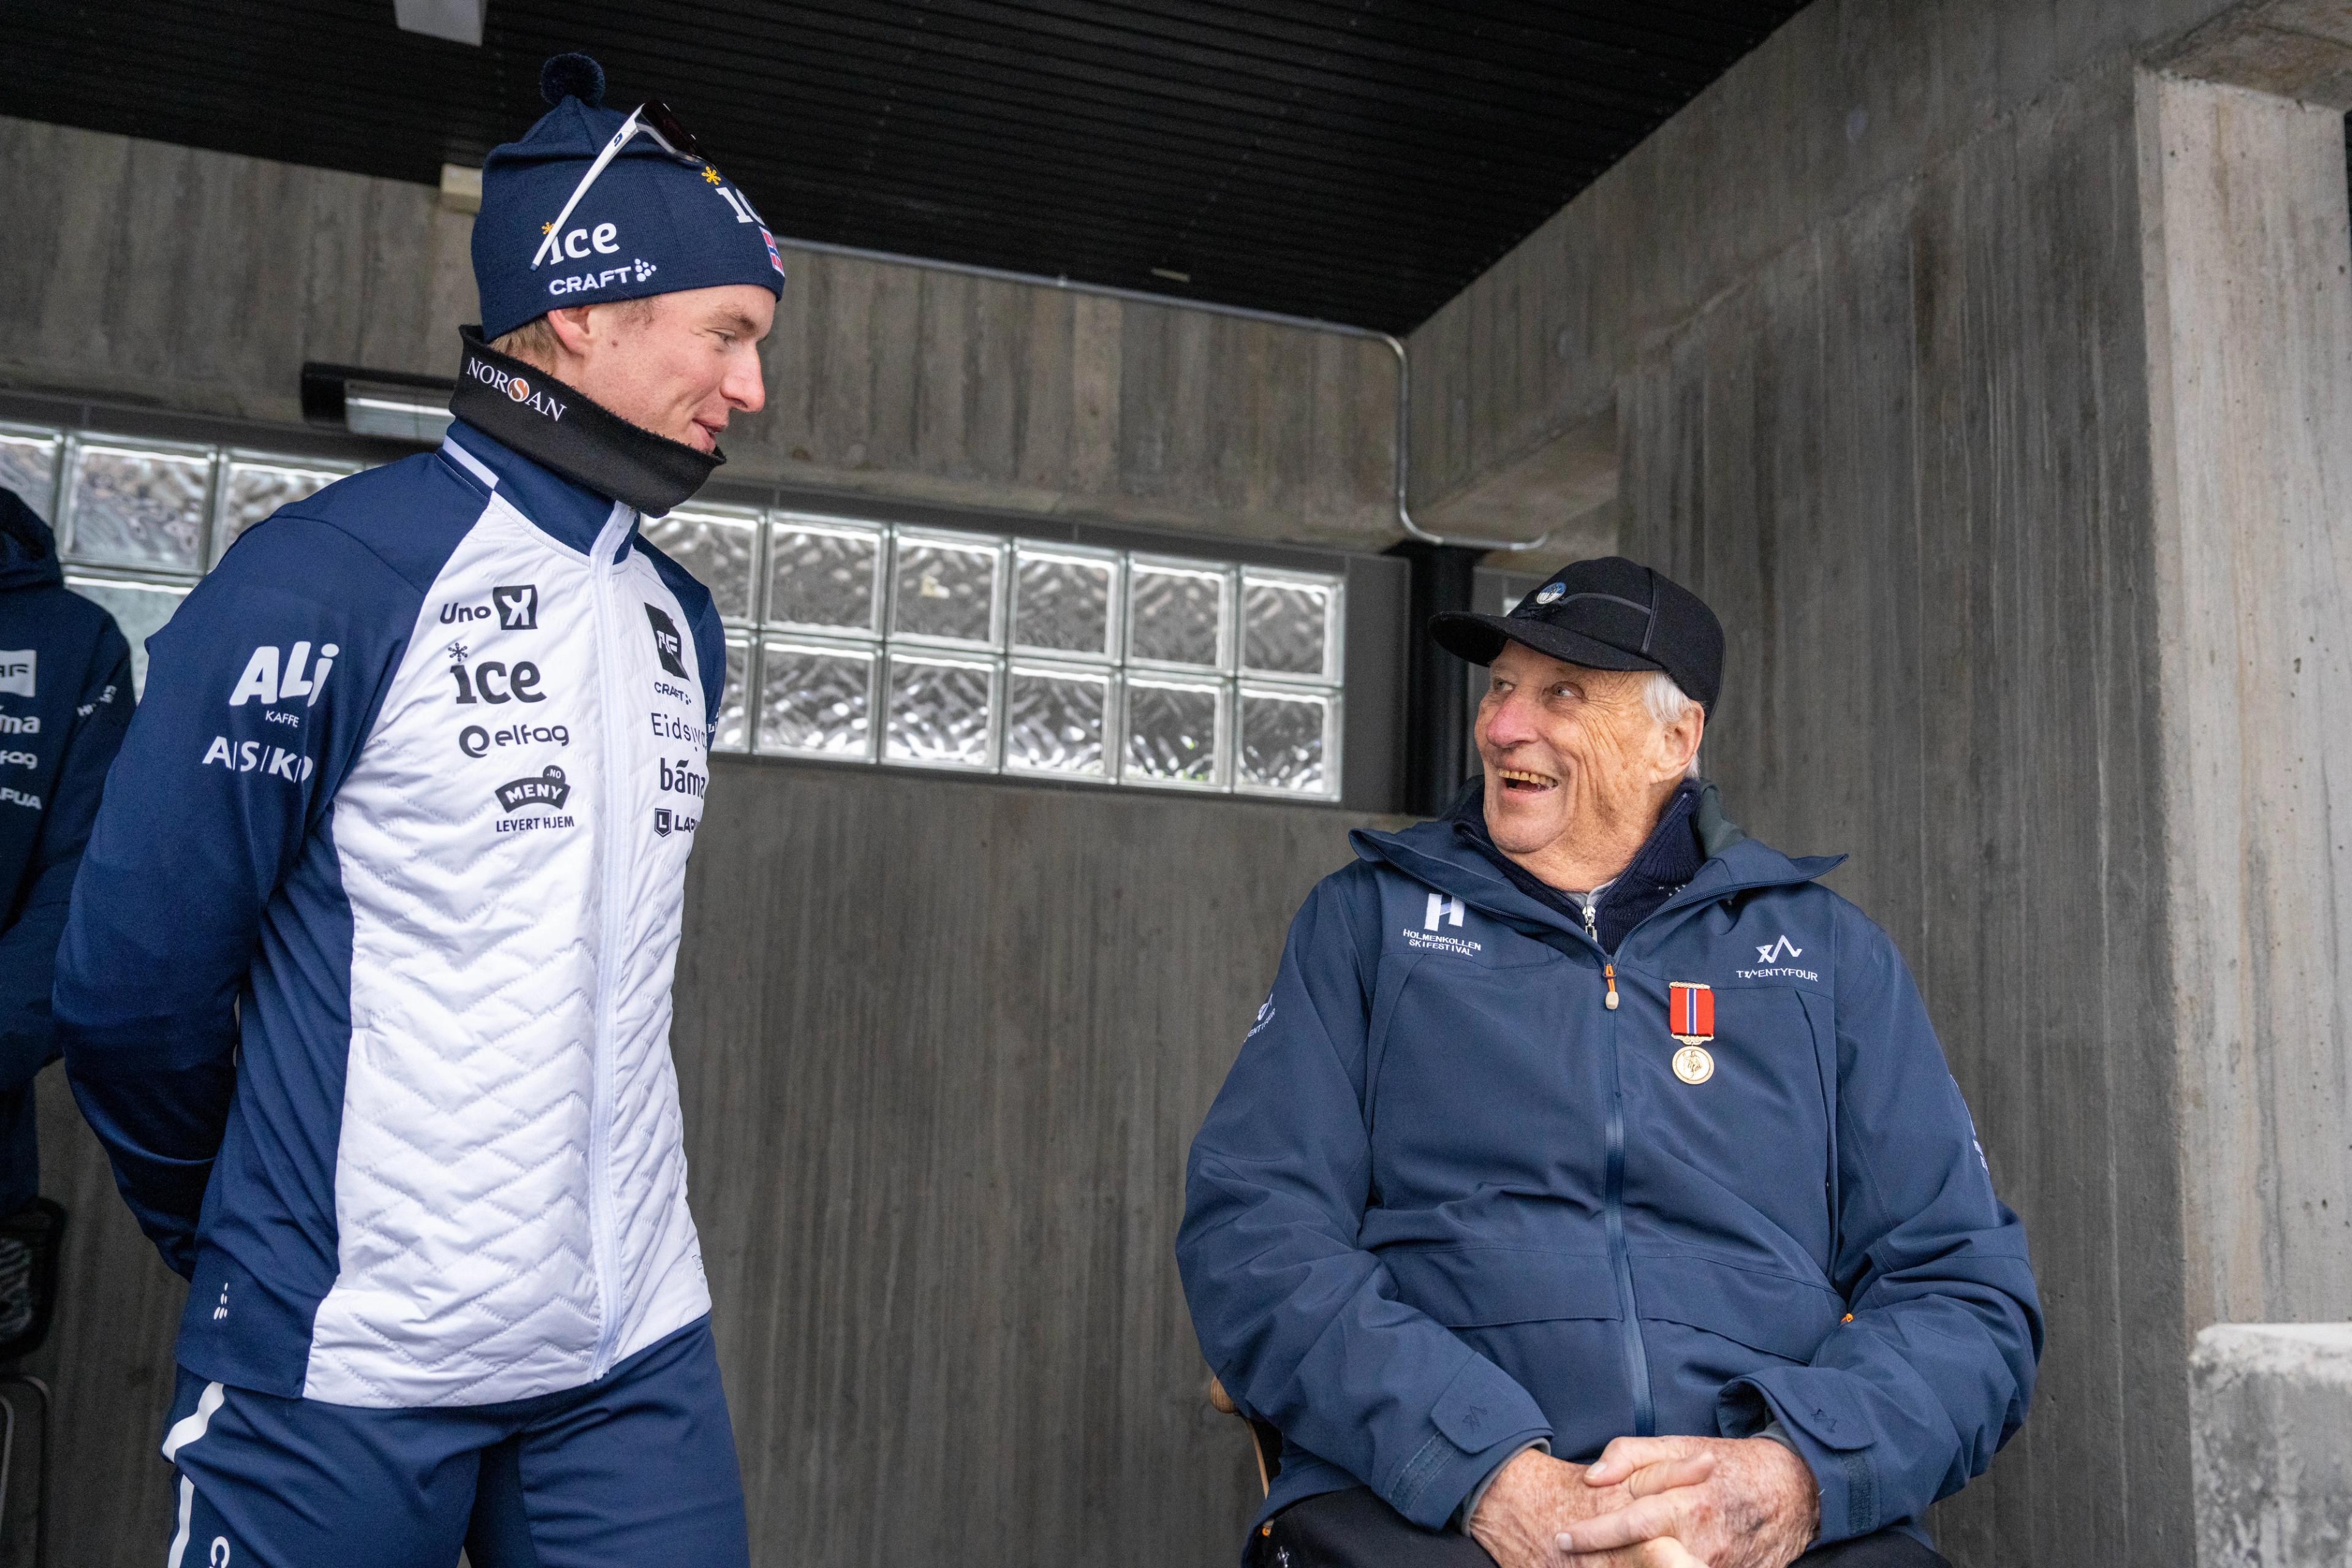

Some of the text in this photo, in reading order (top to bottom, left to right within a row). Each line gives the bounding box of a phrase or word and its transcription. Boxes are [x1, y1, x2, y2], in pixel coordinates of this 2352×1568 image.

[547, 222, 620, 265] ice
[548, 266, 631, 296] CRAFT
[466, 356, 567, 422] NORSAN
[439, 602, 492, 625] Uno
[450, 650, 547, 704] ice
[654, 681, 684, 703] CRAFT
[265, 710, 300, 728] KAFFE
[495, 723, 570, 747] elfag
[0, 786, 42, 810] PUA
[504, 782, 564, 804] MENY
[496, 815, 575, 833] LEVERT HJEM
[1403, 928, 1482, 951] HOLMENKOLLEN
[1735, 968, 1819, 982] TWENTYFOUR
